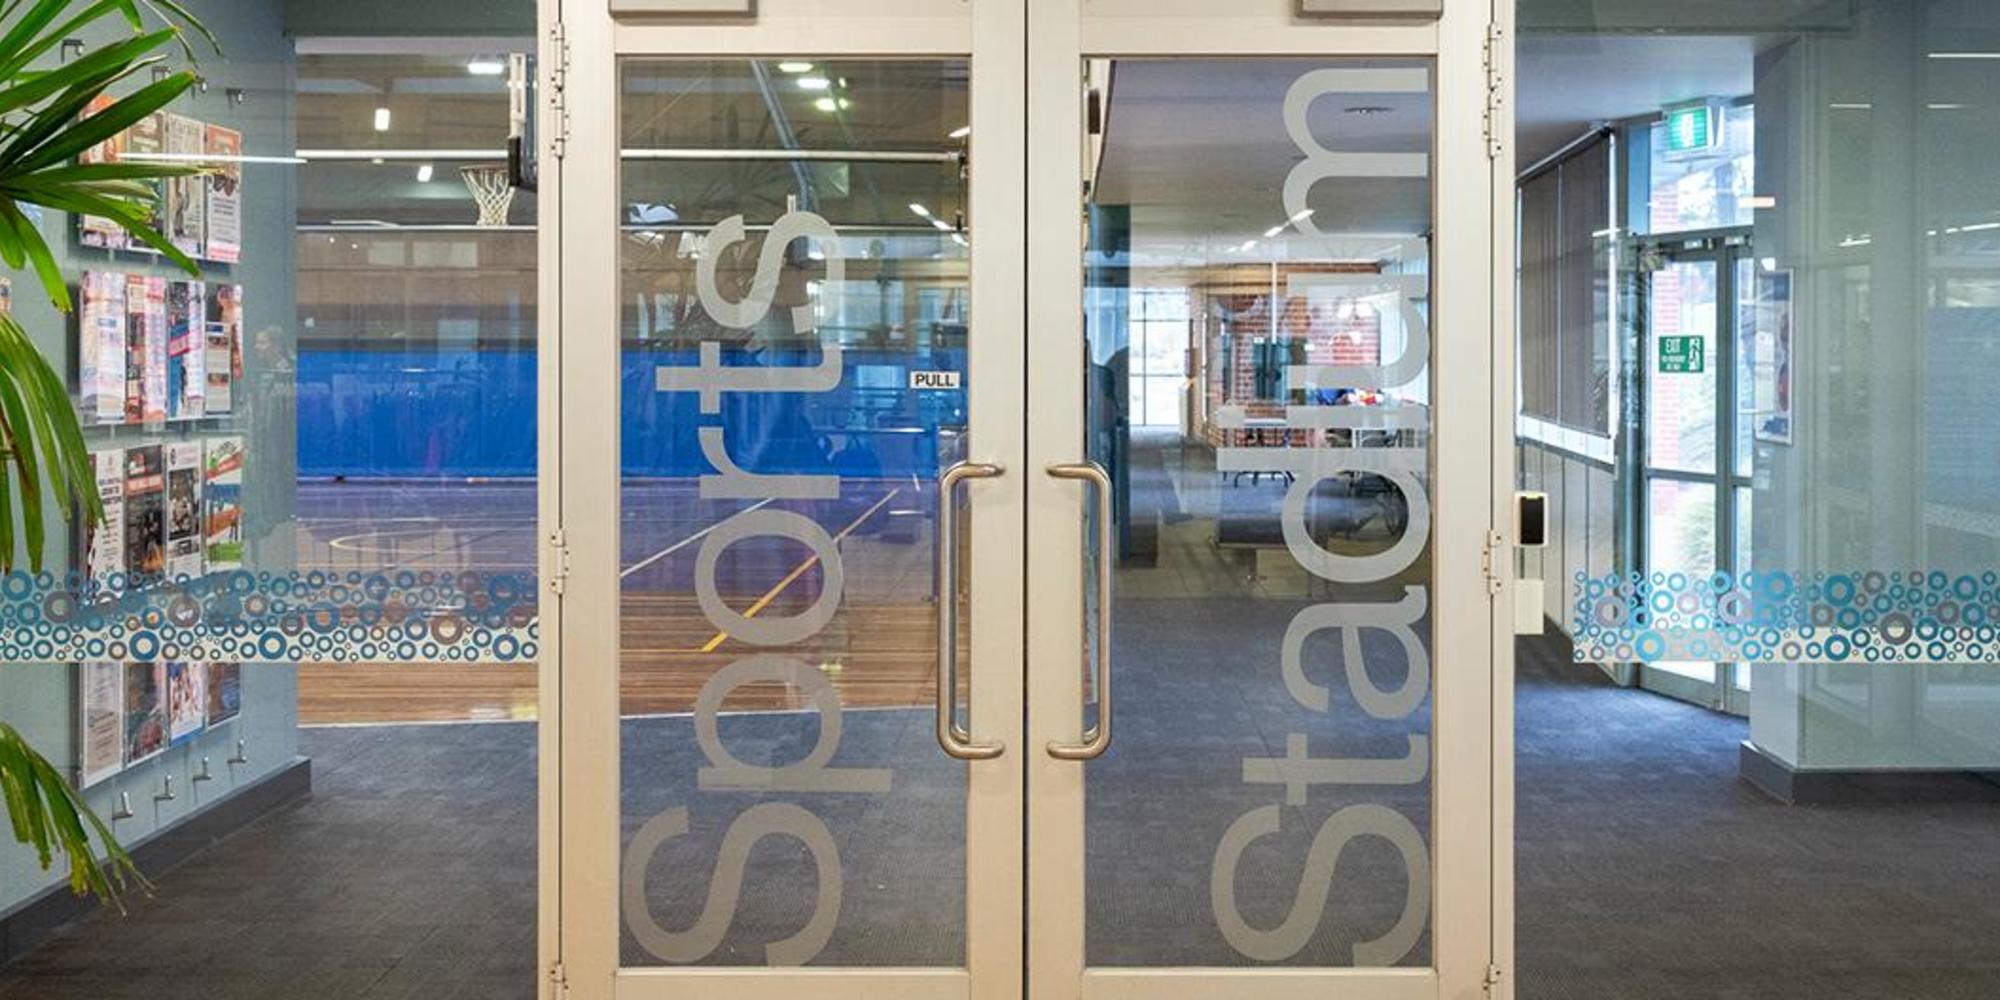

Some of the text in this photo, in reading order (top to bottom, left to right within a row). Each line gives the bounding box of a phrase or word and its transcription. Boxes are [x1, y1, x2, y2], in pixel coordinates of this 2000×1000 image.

[622, 210, 893, 966] Sports
[914, 373, 955, 387] PULL
[1211, 68, 1430, 967] Stadium
